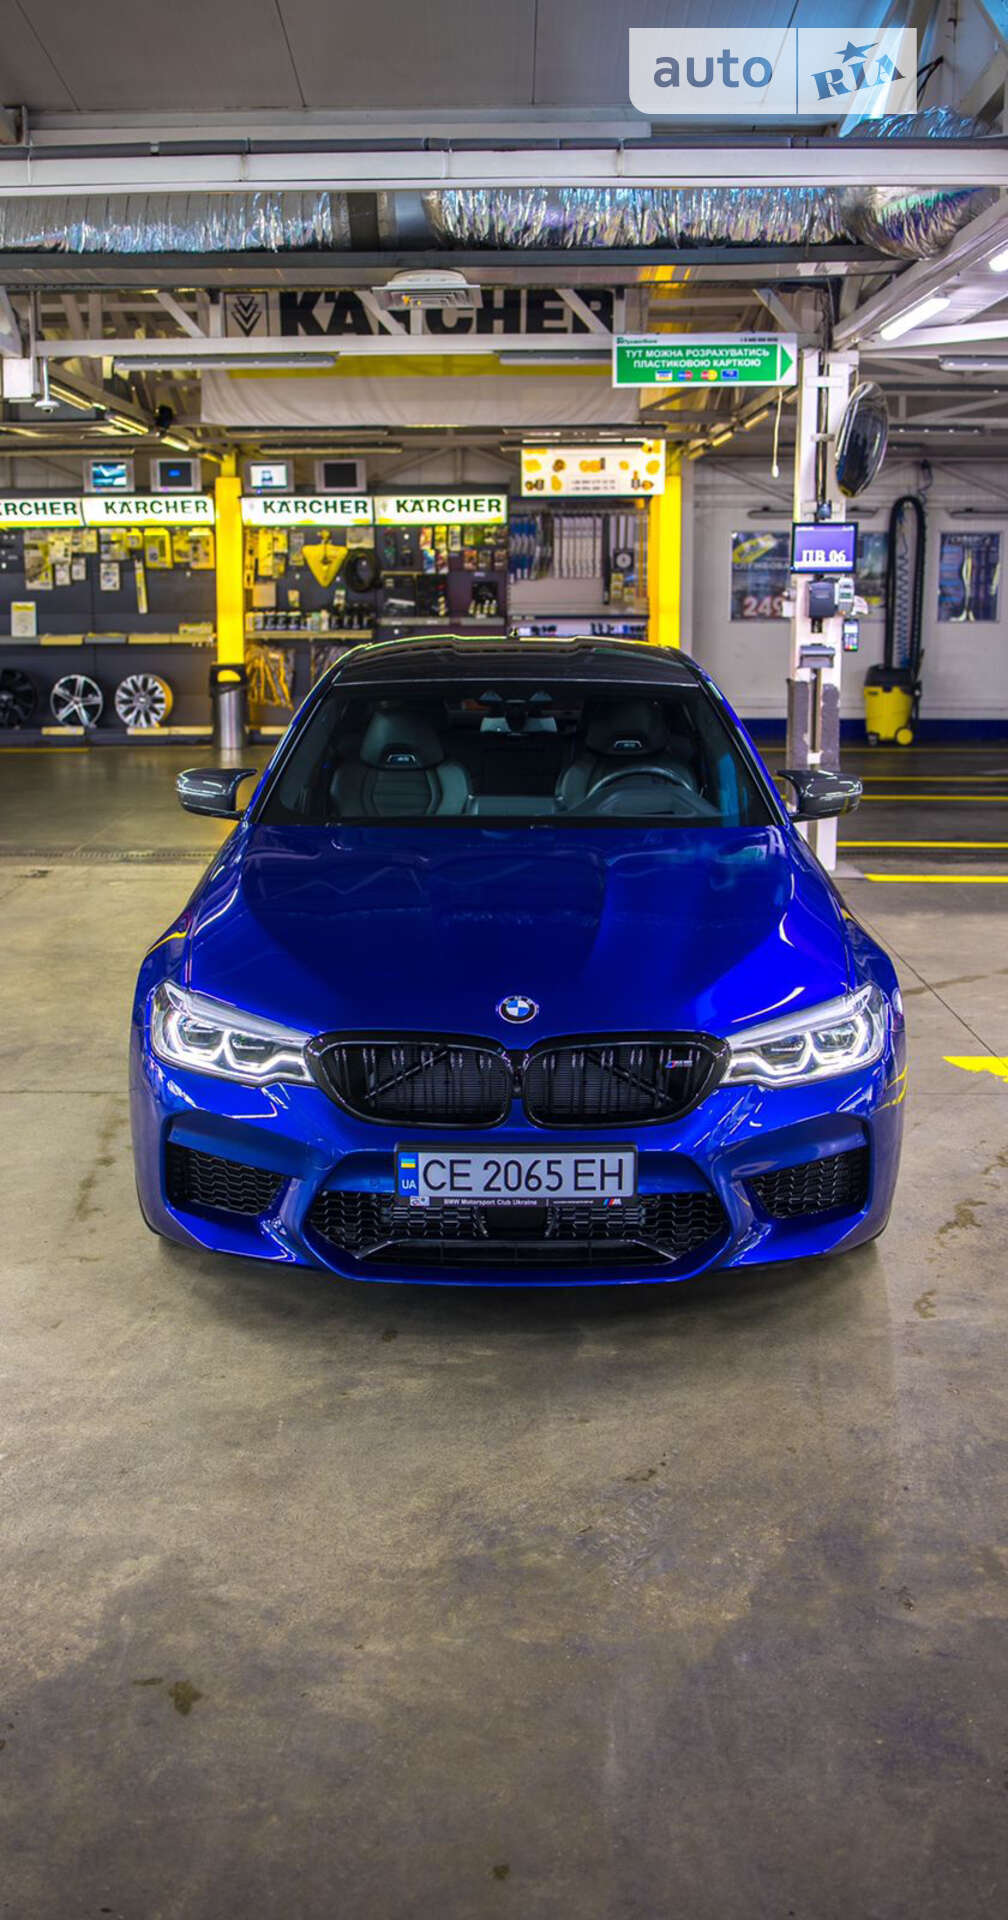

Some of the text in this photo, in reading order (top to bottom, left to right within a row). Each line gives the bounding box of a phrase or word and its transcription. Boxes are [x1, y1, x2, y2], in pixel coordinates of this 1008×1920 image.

[625, 348, 770, 359] ТУТ МОЖНА РОЗРАХУВАТИСЬ
[633, 358, 762, 368] ПЛАСТИКОВОЮ КАРТКОЮ
[0, 501, 78, 515] RCHER
[104, 500, 209, 514] KÄRCHER
[263, 499, 368, 514] KÄRCHER
[395, 498, 502, 513] KÄRCHER
[828, 549, 847, 562] 06
[422, 1158, 623, 1192] CE 2065 EH
[401, 1179, 417, 1190] UA
[443, 1198, 537, 1207] BMW Motorsport Club Ukraine
